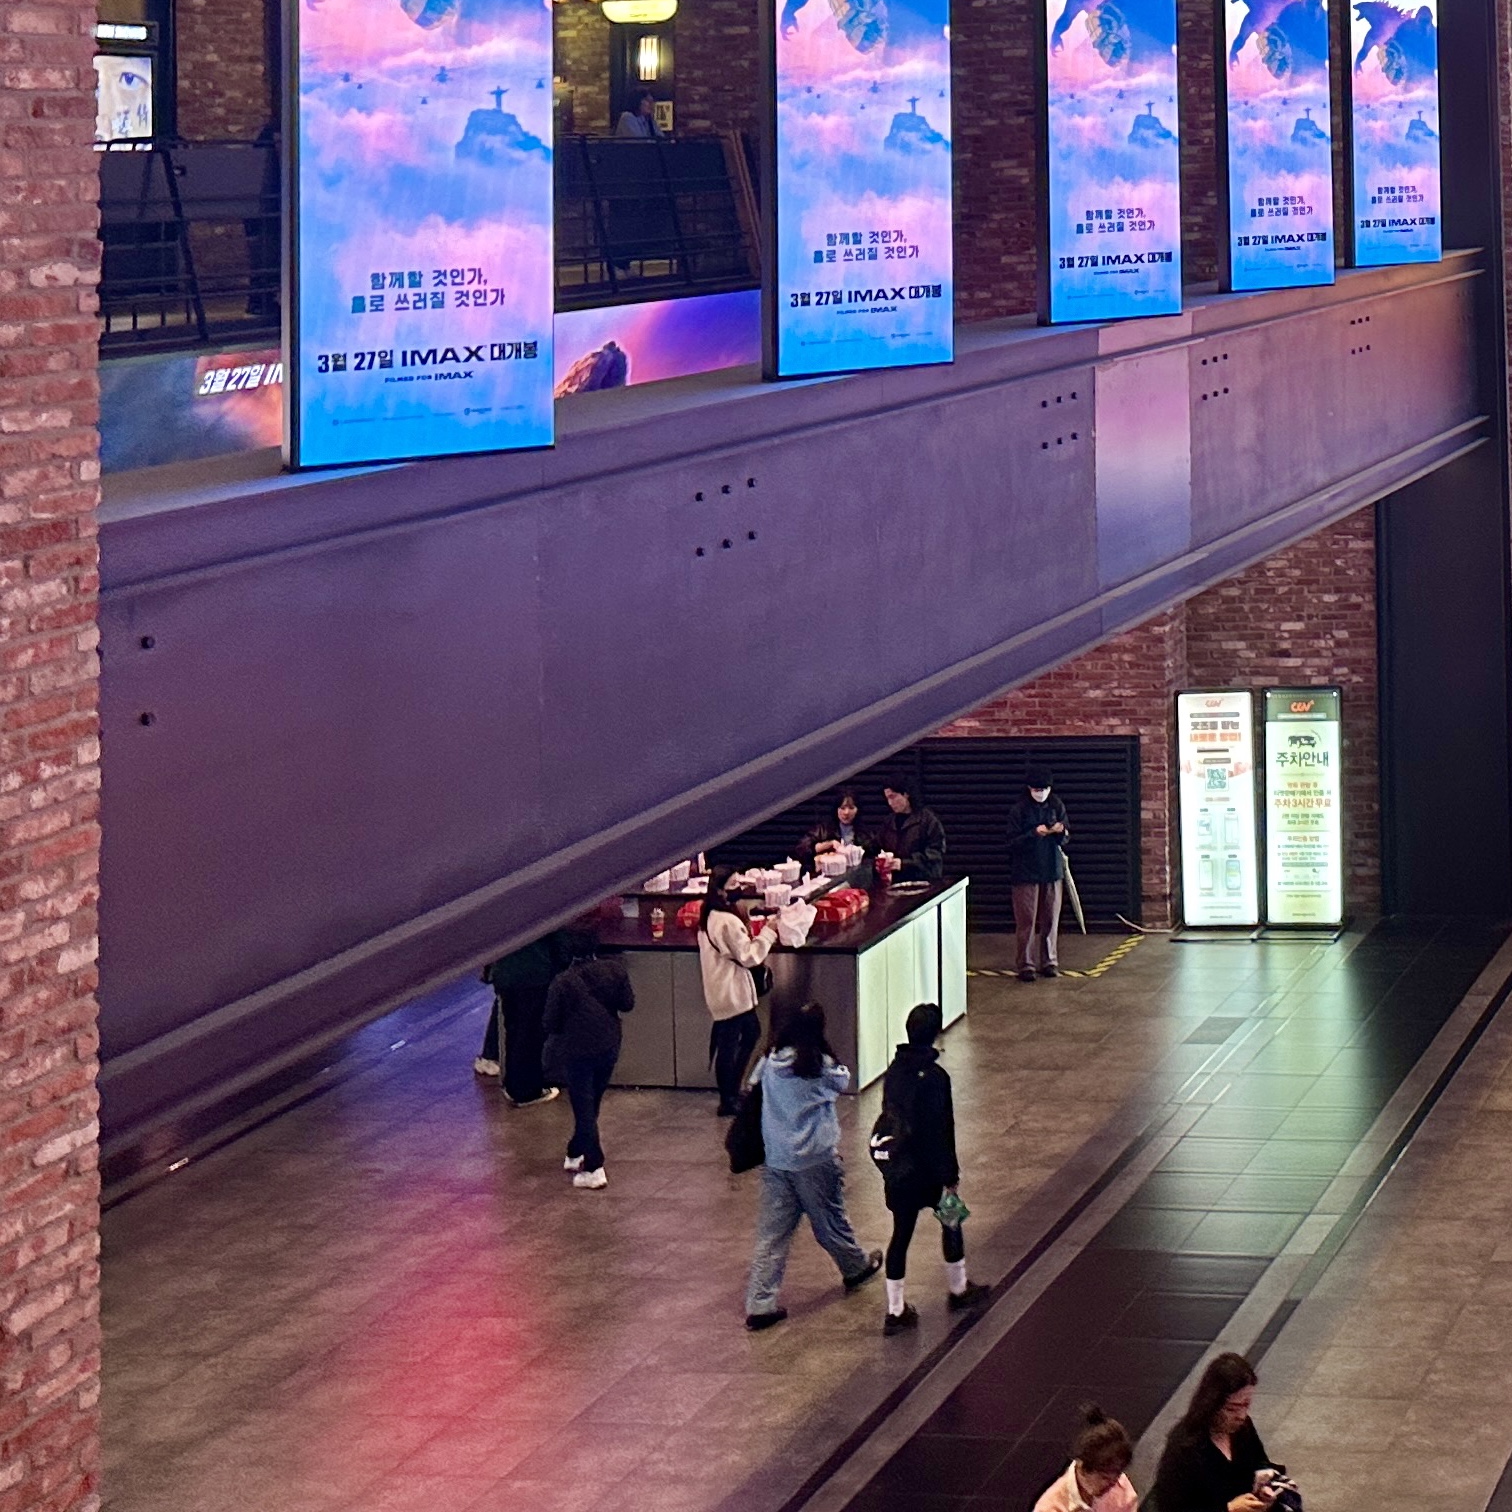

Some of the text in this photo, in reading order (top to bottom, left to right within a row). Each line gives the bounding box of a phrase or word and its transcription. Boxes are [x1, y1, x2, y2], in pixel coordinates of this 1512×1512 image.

[1271, 233, 1304, 244] IMAX
[884, 245, 919, 259] 것인가
[1102, 253, 1145, 266] IMAX
[370, 268, 488, 290] 함께할 것인가,
[394, 291, 445, 311] 쓰러질
[454, 288, 505, 308] 것인가
[790, 293, 810, 307] 3월
[815, 290, 842, 306] 27일
[848, 286, 906, 304] IMAX
[318, 341, 537, 373] 3월 27일 IMAX 대개봉
[199, 368, 231, 394] 3월
[226, 364, 265, 391] 27일
[434, 370, 473, 381] IMAX
[1291, 699, 1315, 712] CGV
[1276, 751, 1329, 768] 주차안내
